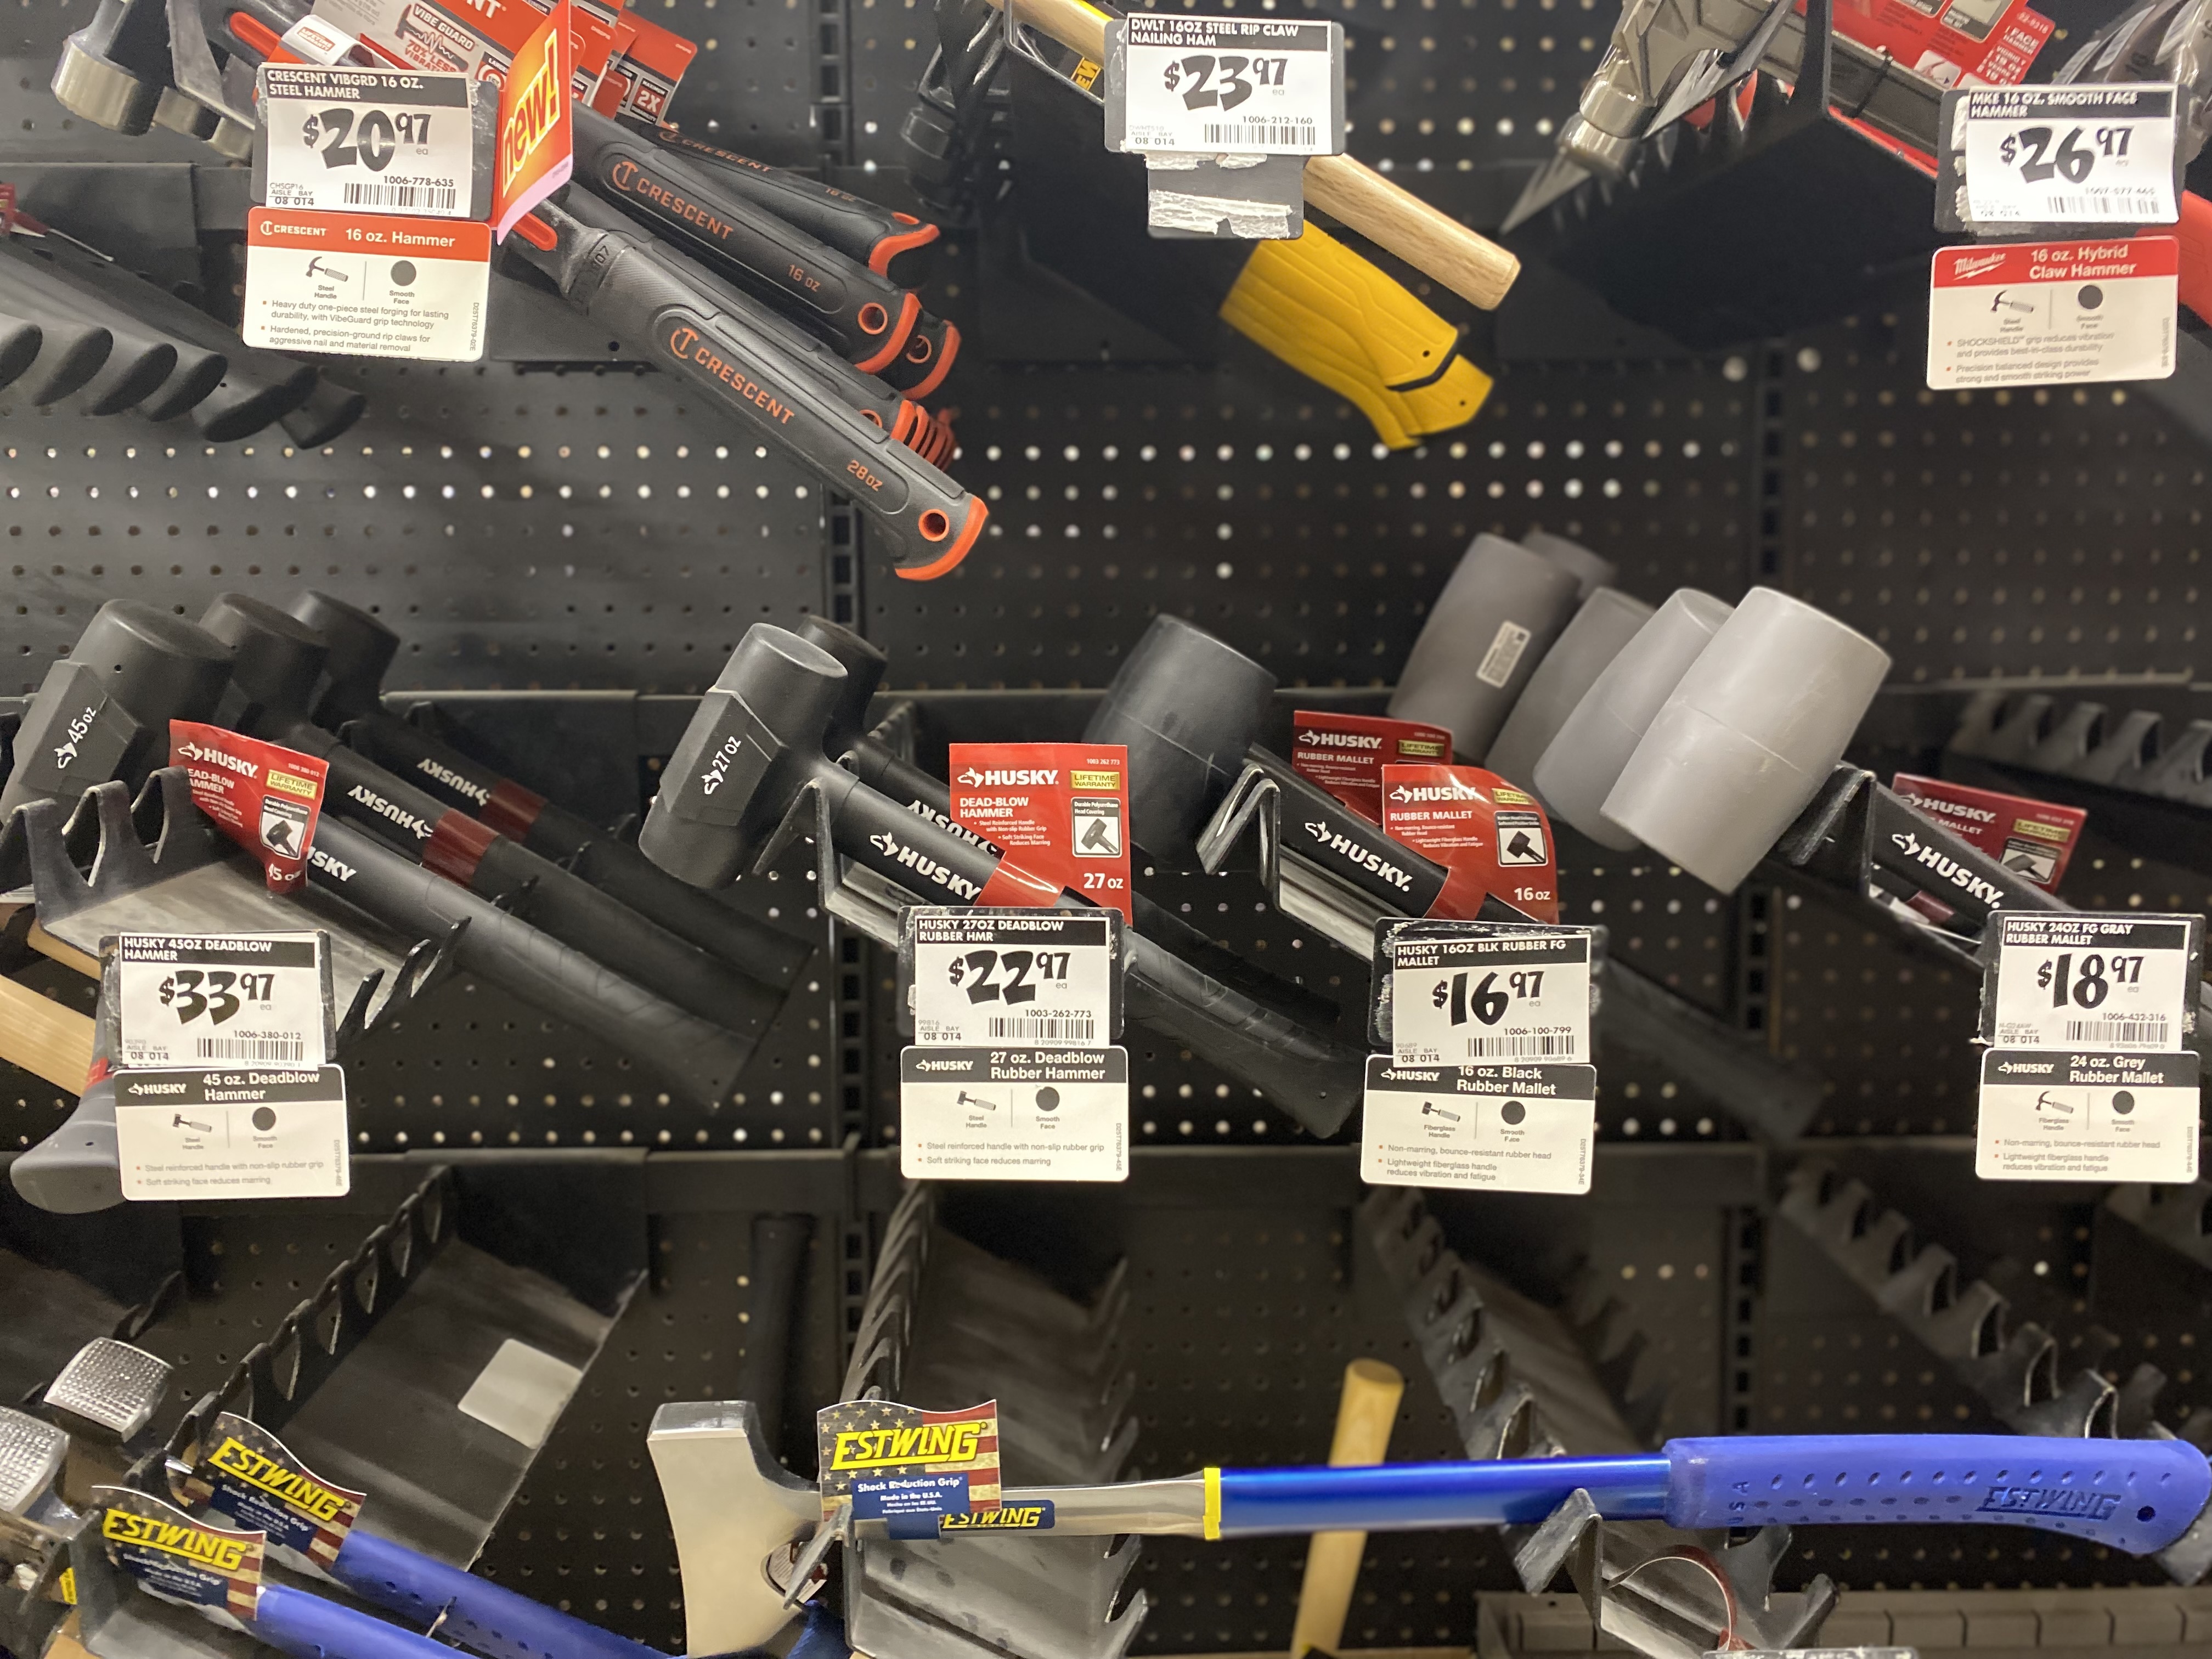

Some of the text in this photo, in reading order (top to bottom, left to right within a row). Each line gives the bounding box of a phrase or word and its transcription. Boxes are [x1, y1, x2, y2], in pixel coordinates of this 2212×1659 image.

[415, 6, 438, 26] VIBE
[438, 23, 473, 49] GUARD
[1131, 19, 1299, 37] DWLT 16OZ STEEL RIP CLAW
[1131, 32, 1217, 46] NAILING HAM
[407, 40, 456, 72] 70% LESS
[267, 70, 424, 89] CRESCENT VIBGRD 16 OZ.
[269, 85, 361, 99] STEEL HAMMER
[2004, 93, 2020, 104] 16
[2047, 93, 2105, 105] SMOOTH
[2106, 92, 2138, 104] FACE
[637, 91, 661, 112] 2X
[503, 27, 561, 197] new!
[1971, 106, 2028, 118] HAMMER
[1243, 116, 1313, 124] 1006-212-160
[681, 137, 773, 173] CRESCENT
[384, 175, 454, 187] 1006-778-635
[636, 176, 734, 241] CRESCENT
[274, 225, 455, 247] CRESCENT 16 oz. Hammer
[1954, 245, 2128, 275] Milwaukee 16 oz. Hybrid
[2030, 263, 2136, 279] Claw Hammer
[1956, 369, 2090, 384] strong and smooth striking power
[695, 346, 795, 425] CRESCENT
[1321, 733, 1381, 749] HUSKY
[204, 748, 258, 778] HUSKY
[1297, 752, 1374, 764] RUBBER MALLET
[417, 758, 477, 799] HUSKY
[985, 770, 1058, 786] HUSKY
[347, 785, 415, 830] HUSKY
[960, 797, 1029, 807] DEAD-BLOW
[960, 808, 1013, 818] HAMMER
[1390, 811, 1472, 821] RUBBER MALLET
[1922, 798, 1997, 822] HUSKY
[897, 846, 982, 900] HUSKY
[1084, 873, 1124, 889] 27 oz
[1514, 887, 1550, 901] 16 oz
[919, 920, 1064, 931] HUSKY 27OZ DEADBLOW
[2007, 922, 2134, 934] HUSKY 24OZ FG GRAY
[919, 932, 993, 941] RUBBER HMR
[2006, 934, 2093, 945] RUBBER MALLET
[125, 937, 272, 952] HUSKY 45OZ DEADBLOW
[1397, 940, 1566, 956] HUSKY 16OZ BLK RUBBER FG
[125, 949, 178, 961] HAMMER
[1397, 956, 1440, 967] MALLET
[1025, 1009, 1091, 1018] 1003-262-773
[2102, 1013, 2166, 1021] 1006-432-316
[233, 1030, 301, 1040] 1006-380-012
[1504, 1027, 1571, 1035] 1006-100-799
[932, 1052, 1104, 1071] HUSKY 27 oz. Deadblow
[2013, 1056, 2146, 1074] HUSKY 24 oz. Grey
[991, 1067, 1105, 1079] Rubber Hammer
[1396, 1066, 1542, 1081] HUSKY 16 oz. Black
[2069, 1071, 2164, 1084] Rubber Mallet
[144, 1072, 320, 1094] HUSKY 45 oz. Deadblow
[1457, 1080, 1556, 1096] Rubber Mallet
[204, 1088, 266, 1102] Hammer
[1387, 1159, 1497, 1171] Lightweight fiberglass handle
[163, 1177, 190, 1187] striking
[241, 1176, 270, 1185] marring
[830, 1421, 981, 1471] ESTWING
[207, 1436, 345, 1522] ESTWING
[857, 1483, 887, 1493] Shock
[938, 1478, 960, 1487] Grip
[1976, 1486, 2121, 1521] ESTWING
[944, 1507, 1042, 1529] ESTWING
[103, 1509, 246, 1570] ESTWING
